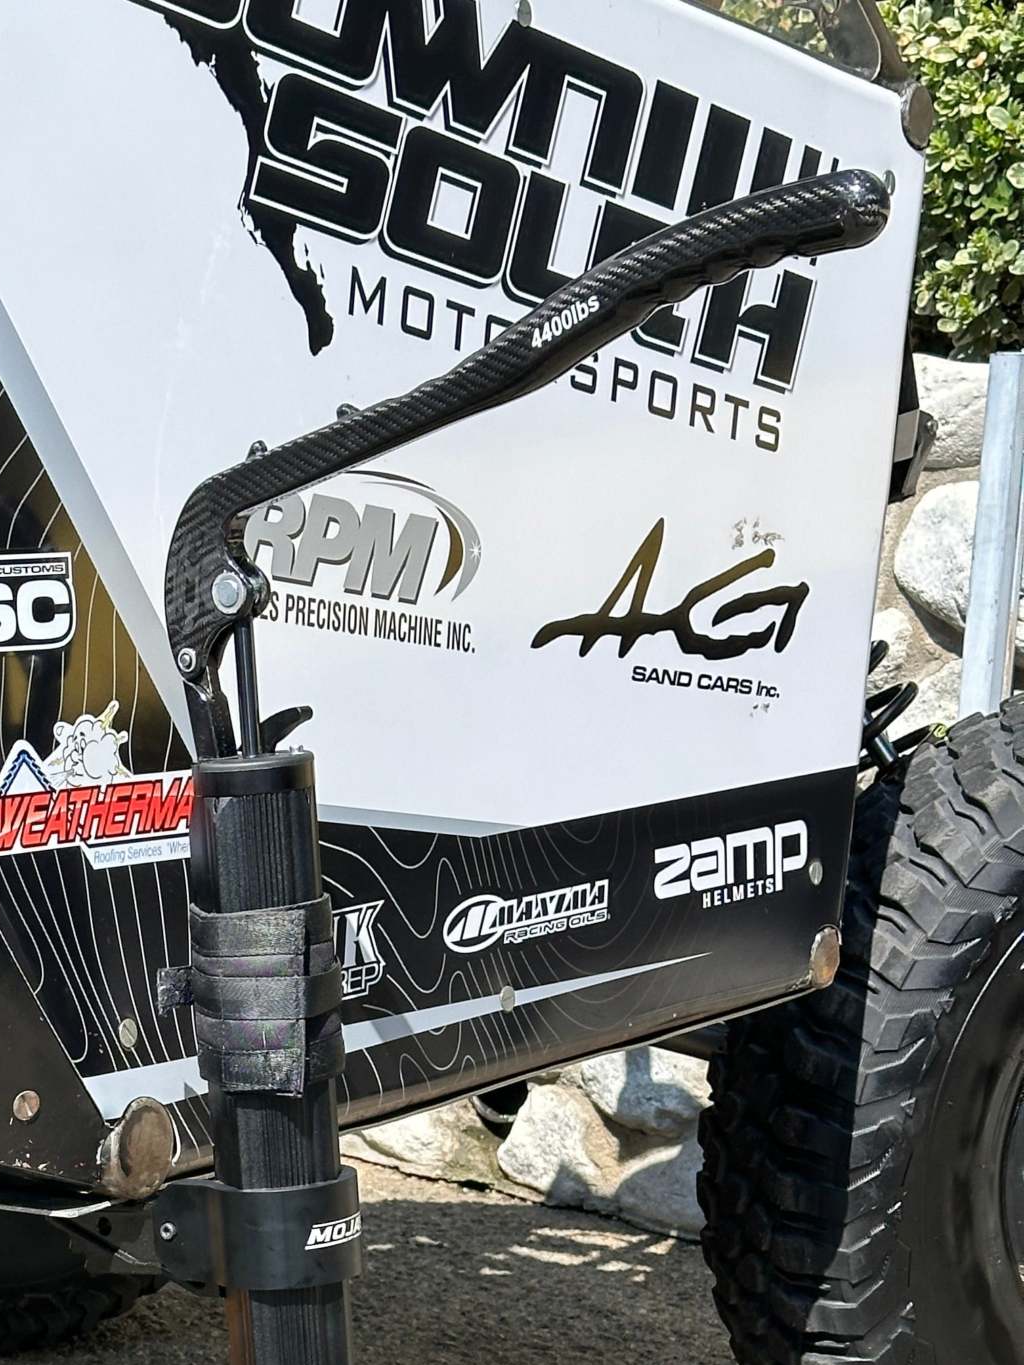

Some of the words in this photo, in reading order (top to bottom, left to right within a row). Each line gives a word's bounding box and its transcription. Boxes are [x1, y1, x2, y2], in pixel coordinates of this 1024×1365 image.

[131, 0, 643, 193] OWN
[531, 295, 600, 348] 4400lbs
[348, 265, 783, 452] MOTSPORTS
[244, 492, 440, 605] RPM
[284, 594, 370, 637] PRECISION
[375, 608, 443, 648] MACHINE
[446, 621, 476, 654] INC.
[631, 666, 693, 688] SAND
[697, 674, 753, 695] CARS
[756, 680, 780, 699] Inc.
[93, 849, 126, 865] Roofing
[127, 844, 163, 861] Services
[654, 819, 808, 900] zamp
[569, 908, 609, 928] OILS
[702, 878, 775, 909] HELMETS
